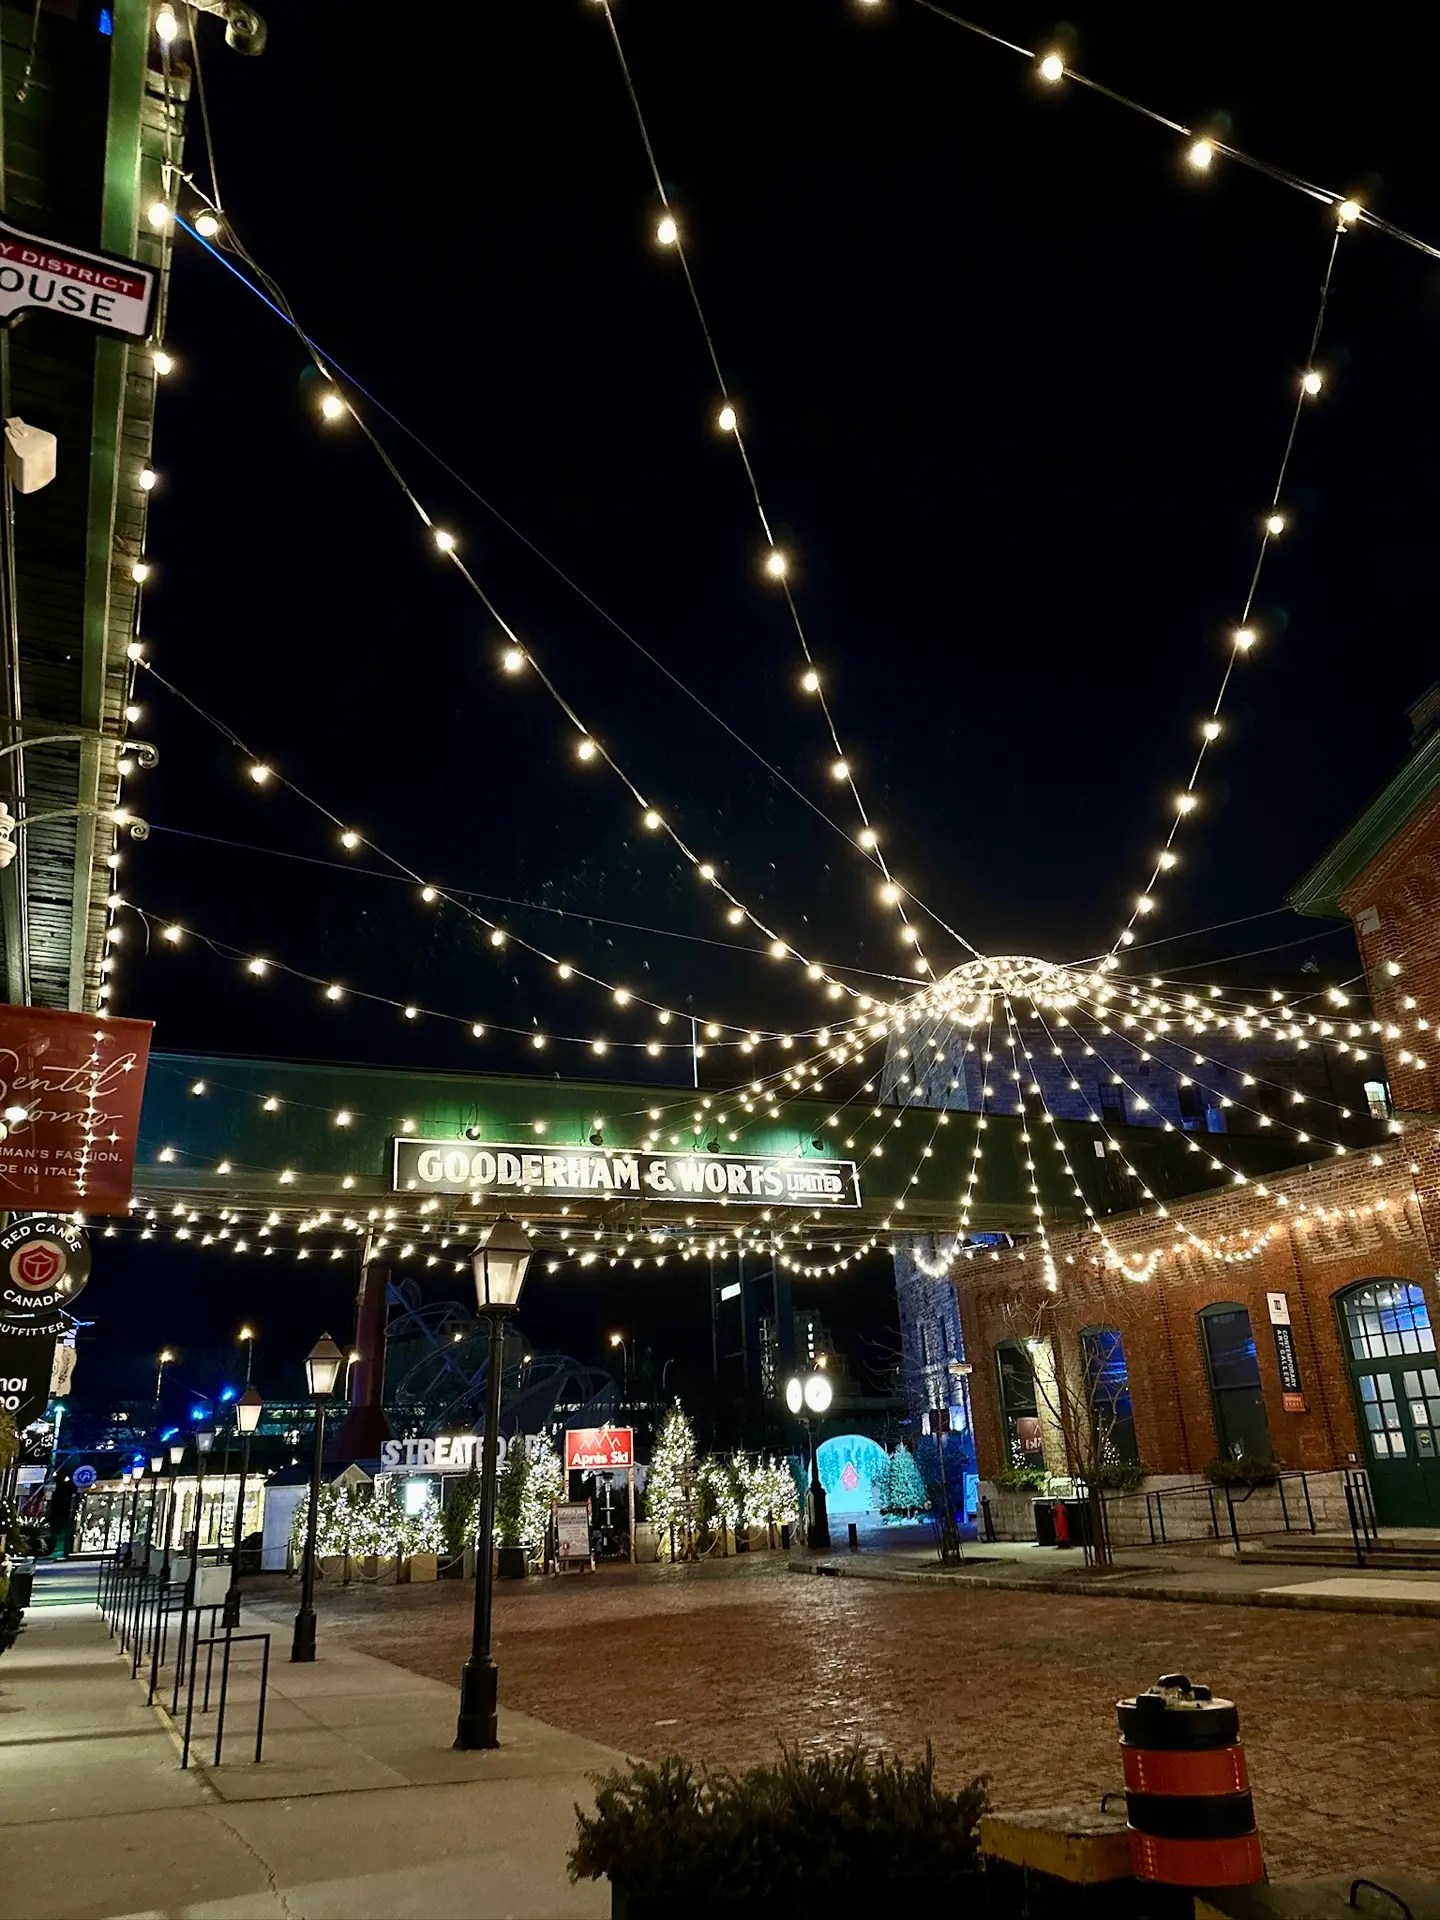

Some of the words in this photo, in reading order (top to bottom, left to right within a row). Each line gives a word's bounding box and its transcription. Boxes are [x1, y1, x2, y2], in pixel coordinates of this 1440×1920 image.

[21, 250, 134, 293] DISTRICT
[0, 1048, 137, 1100] entil
[0, 1147, 49, 1159] MAN'S
[23, 1165, 39, 1175] IN
[417, 1149, 641, 1191] GOODERHAM
[649, 1161, 677, 1192] &
[676, 1161, 784, 1197] WORTS
[785, 1173, 842, 1193] LIMITED
[1, 1225, 31, 1250] RED
[35, 1222, 82, 1253] CANOE
[3, 1289, 65, 1308] CANADA
[0, 1320, 65, 1337] UTFITTER
[1276, 1329, 1285, 1346] ART
[1279, 1349, 1291, 1388] GALLERY
[1282, 1329, 1297, 1388] CONTEMPORARY
[610, 1449, 629, 1464] Ski
